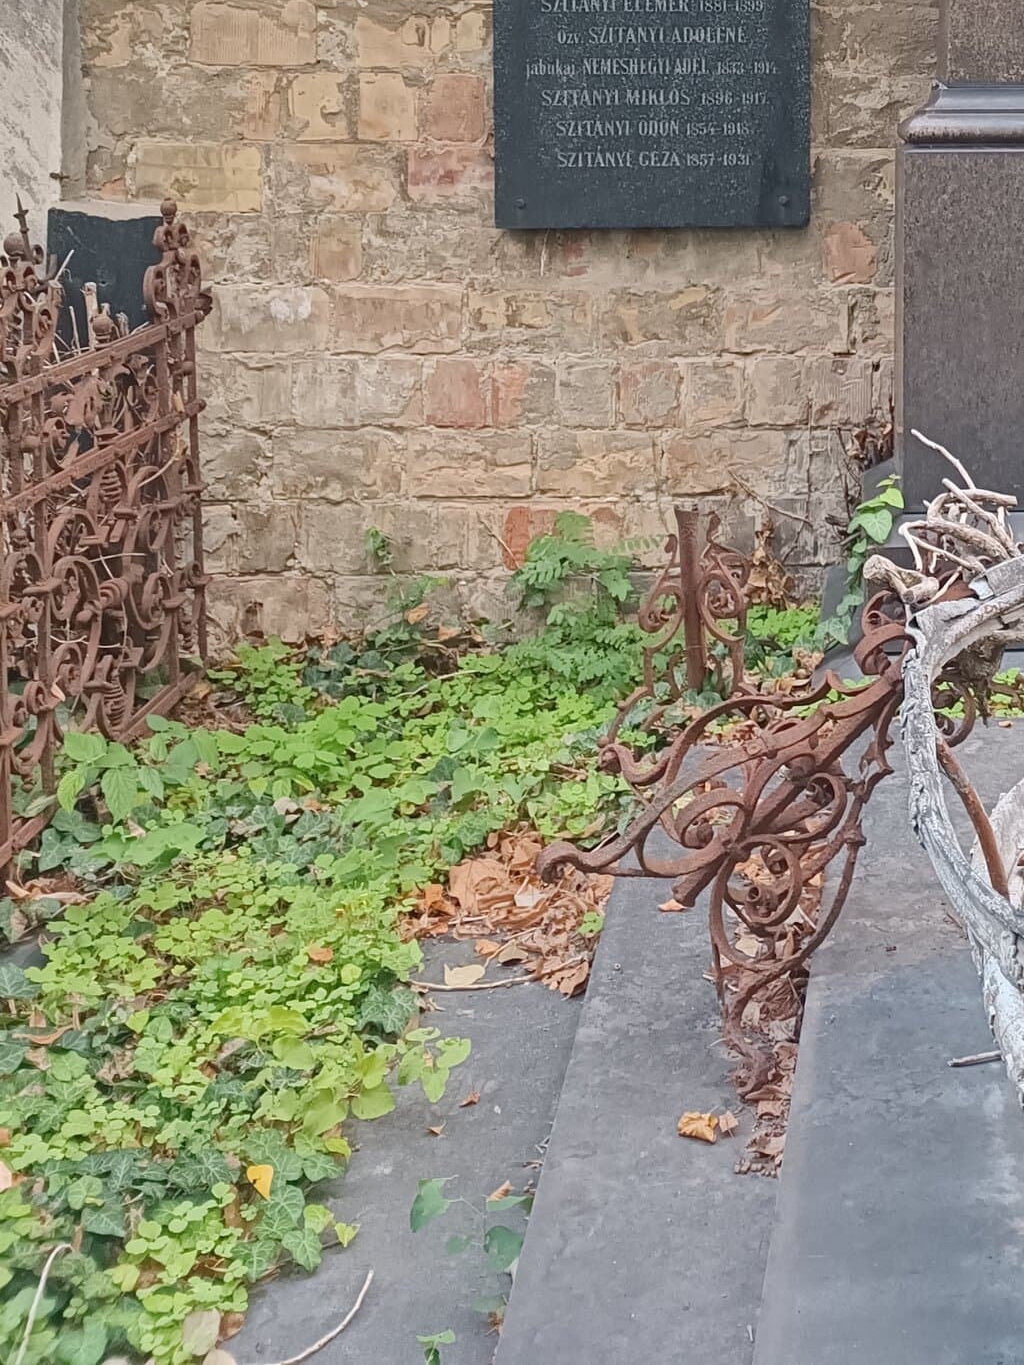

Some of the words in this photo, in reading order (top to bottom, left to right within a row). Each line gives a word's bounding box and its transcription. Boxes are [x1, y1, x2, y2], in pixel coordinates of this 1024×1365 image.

[556, 114, 629, 137] SZITÁNYI
[557, 146, 632, 167] SZITÁNYI
[638, 145, 681, 167] GÉZA
